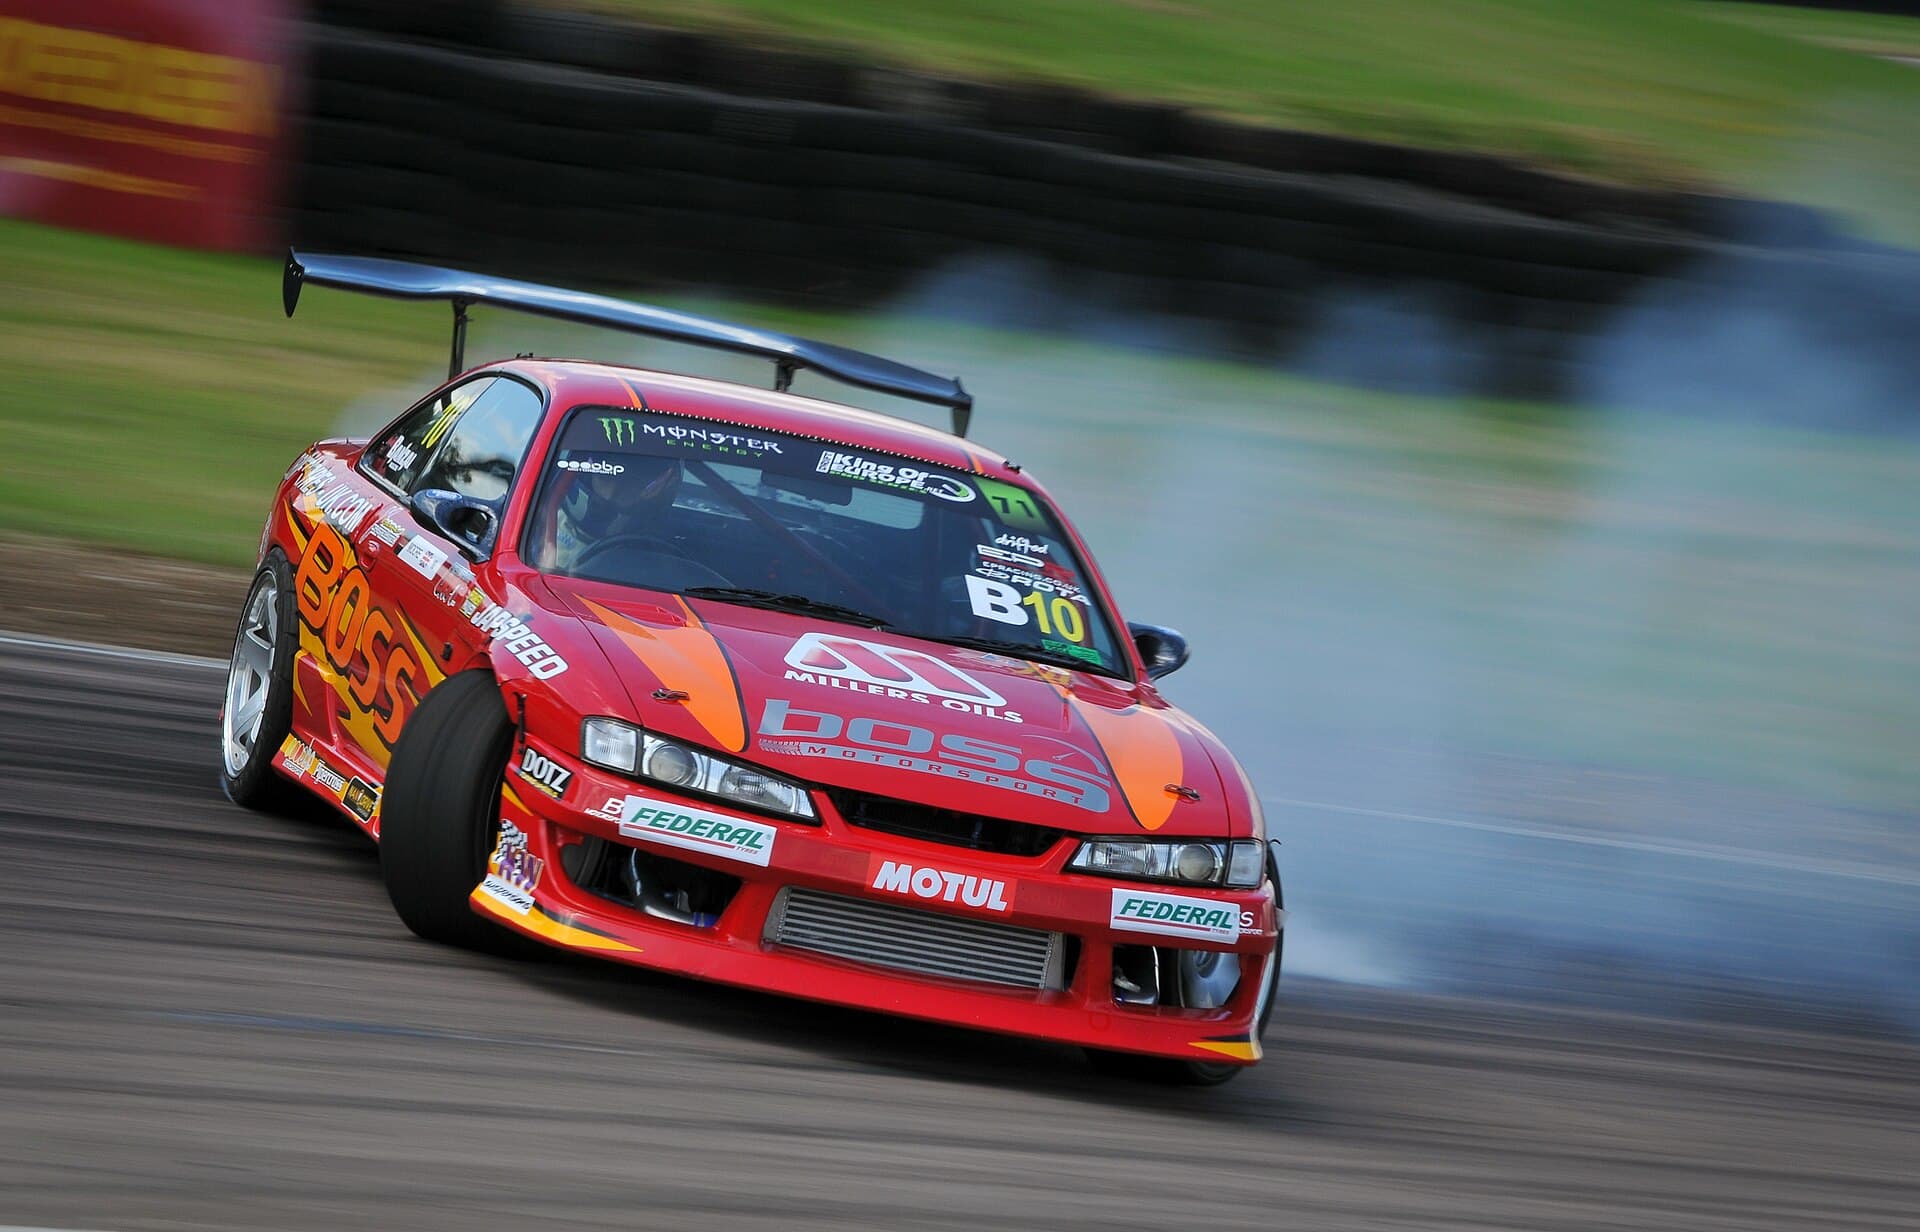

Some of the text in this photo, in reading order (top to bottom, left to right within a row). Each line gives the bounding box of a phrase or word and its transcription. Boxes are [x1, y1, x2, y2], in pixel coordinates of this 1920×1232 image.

[642, 423, 784, 454] MONSTER
[666, 439, 763, 459] ENERGY
[830, 463, 926, 490] EUROPE
[833, 453, 895, 474] King
[994, 533, 1049, 554] drifted
[1010, 574, 1092, 606] ROTA
[295, 519, 418, 748] BOSS
[470, 602, 569, 680] JAPSPEED
[783, 670, 1024, 724] MILLERS OILS
[521, 747, 572, 793] DOTZ
[756, 698, 1113, 814] boss
[807, 744, 1085, 805] MOTORSPORT
[630, 807, 764, 850] FEDERAL
[872, 860, 1008, 912] MOTUL
[1119, 898, 1233, 930] FEDERAL
